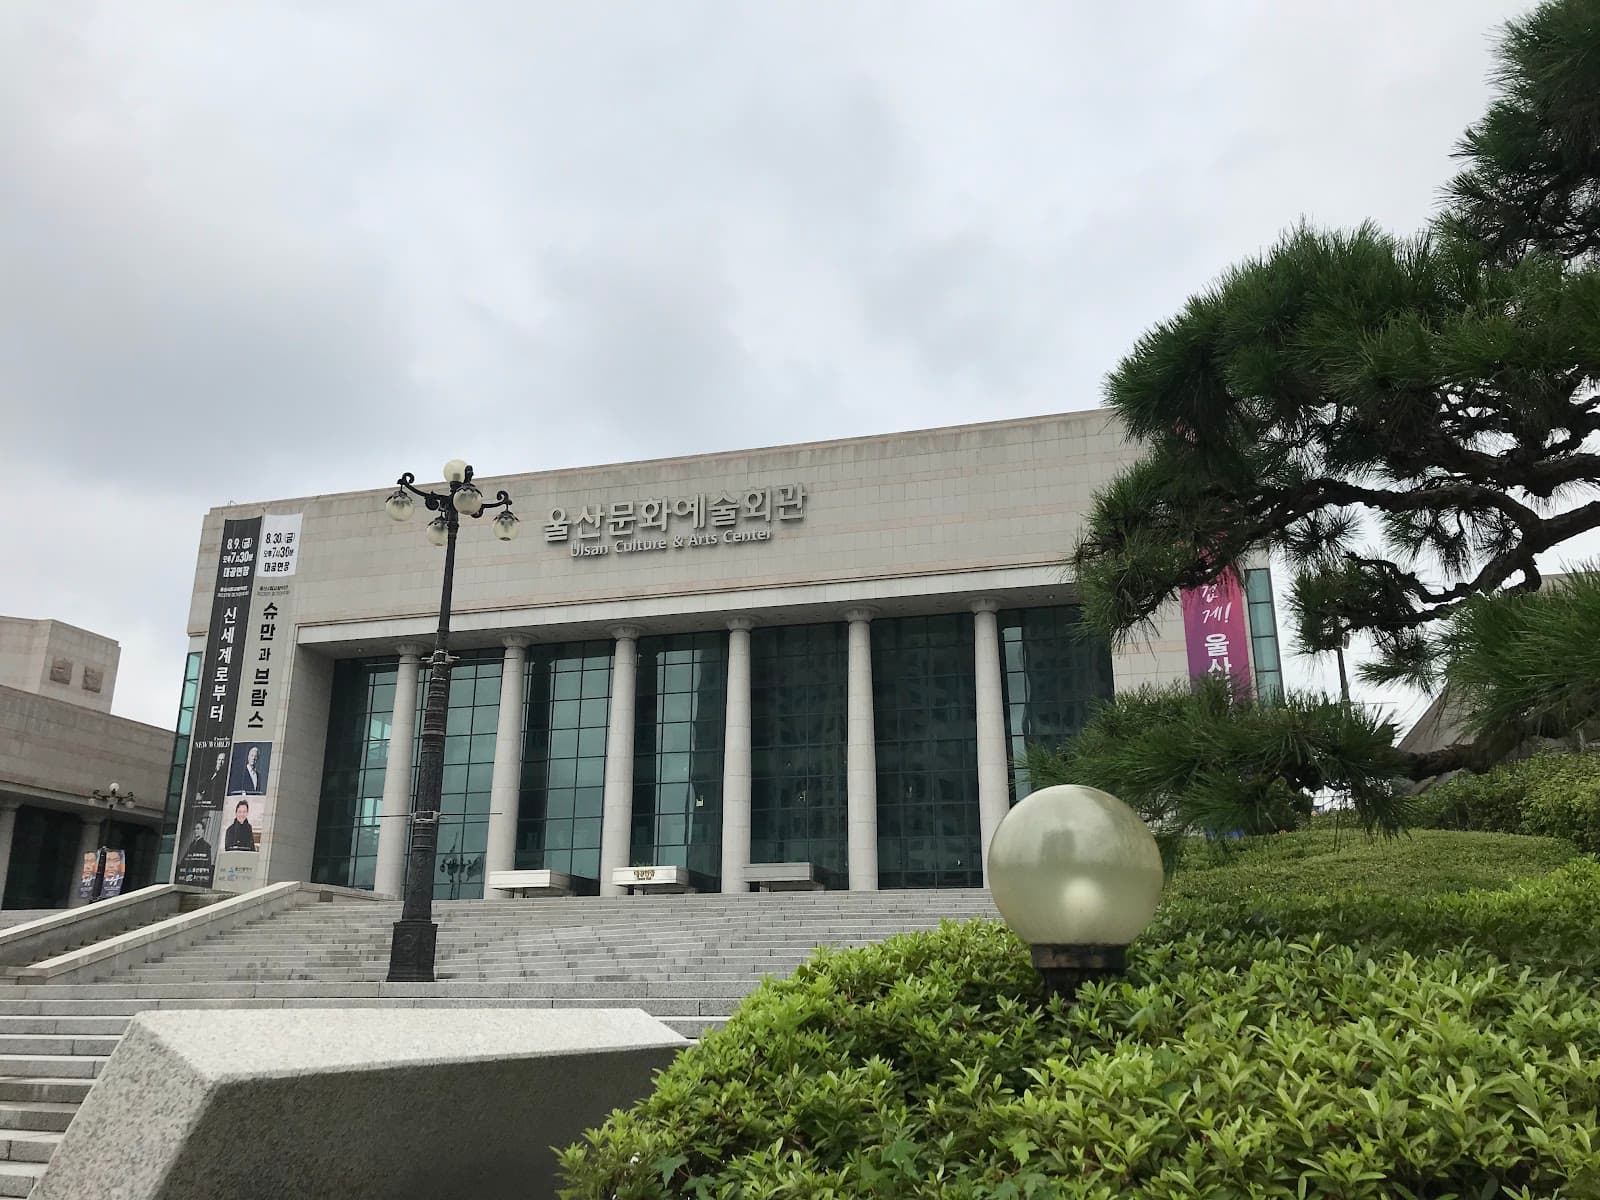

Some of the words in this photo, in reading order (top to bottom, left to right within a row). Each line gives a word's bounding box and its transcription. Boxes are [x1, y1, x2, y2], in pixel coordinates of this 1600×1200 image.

[544, 482, 808, 543] 울산문화예술회관
[570, 540, 609, 557] Ulsan
[615, 537, 667, 553] Culture
[672, 534, 684, 547] &
[688, 532, 718, 546] Arts
[723, 526, 773, 543] Center
[209, 606, 238, 723] 신세계로부터
